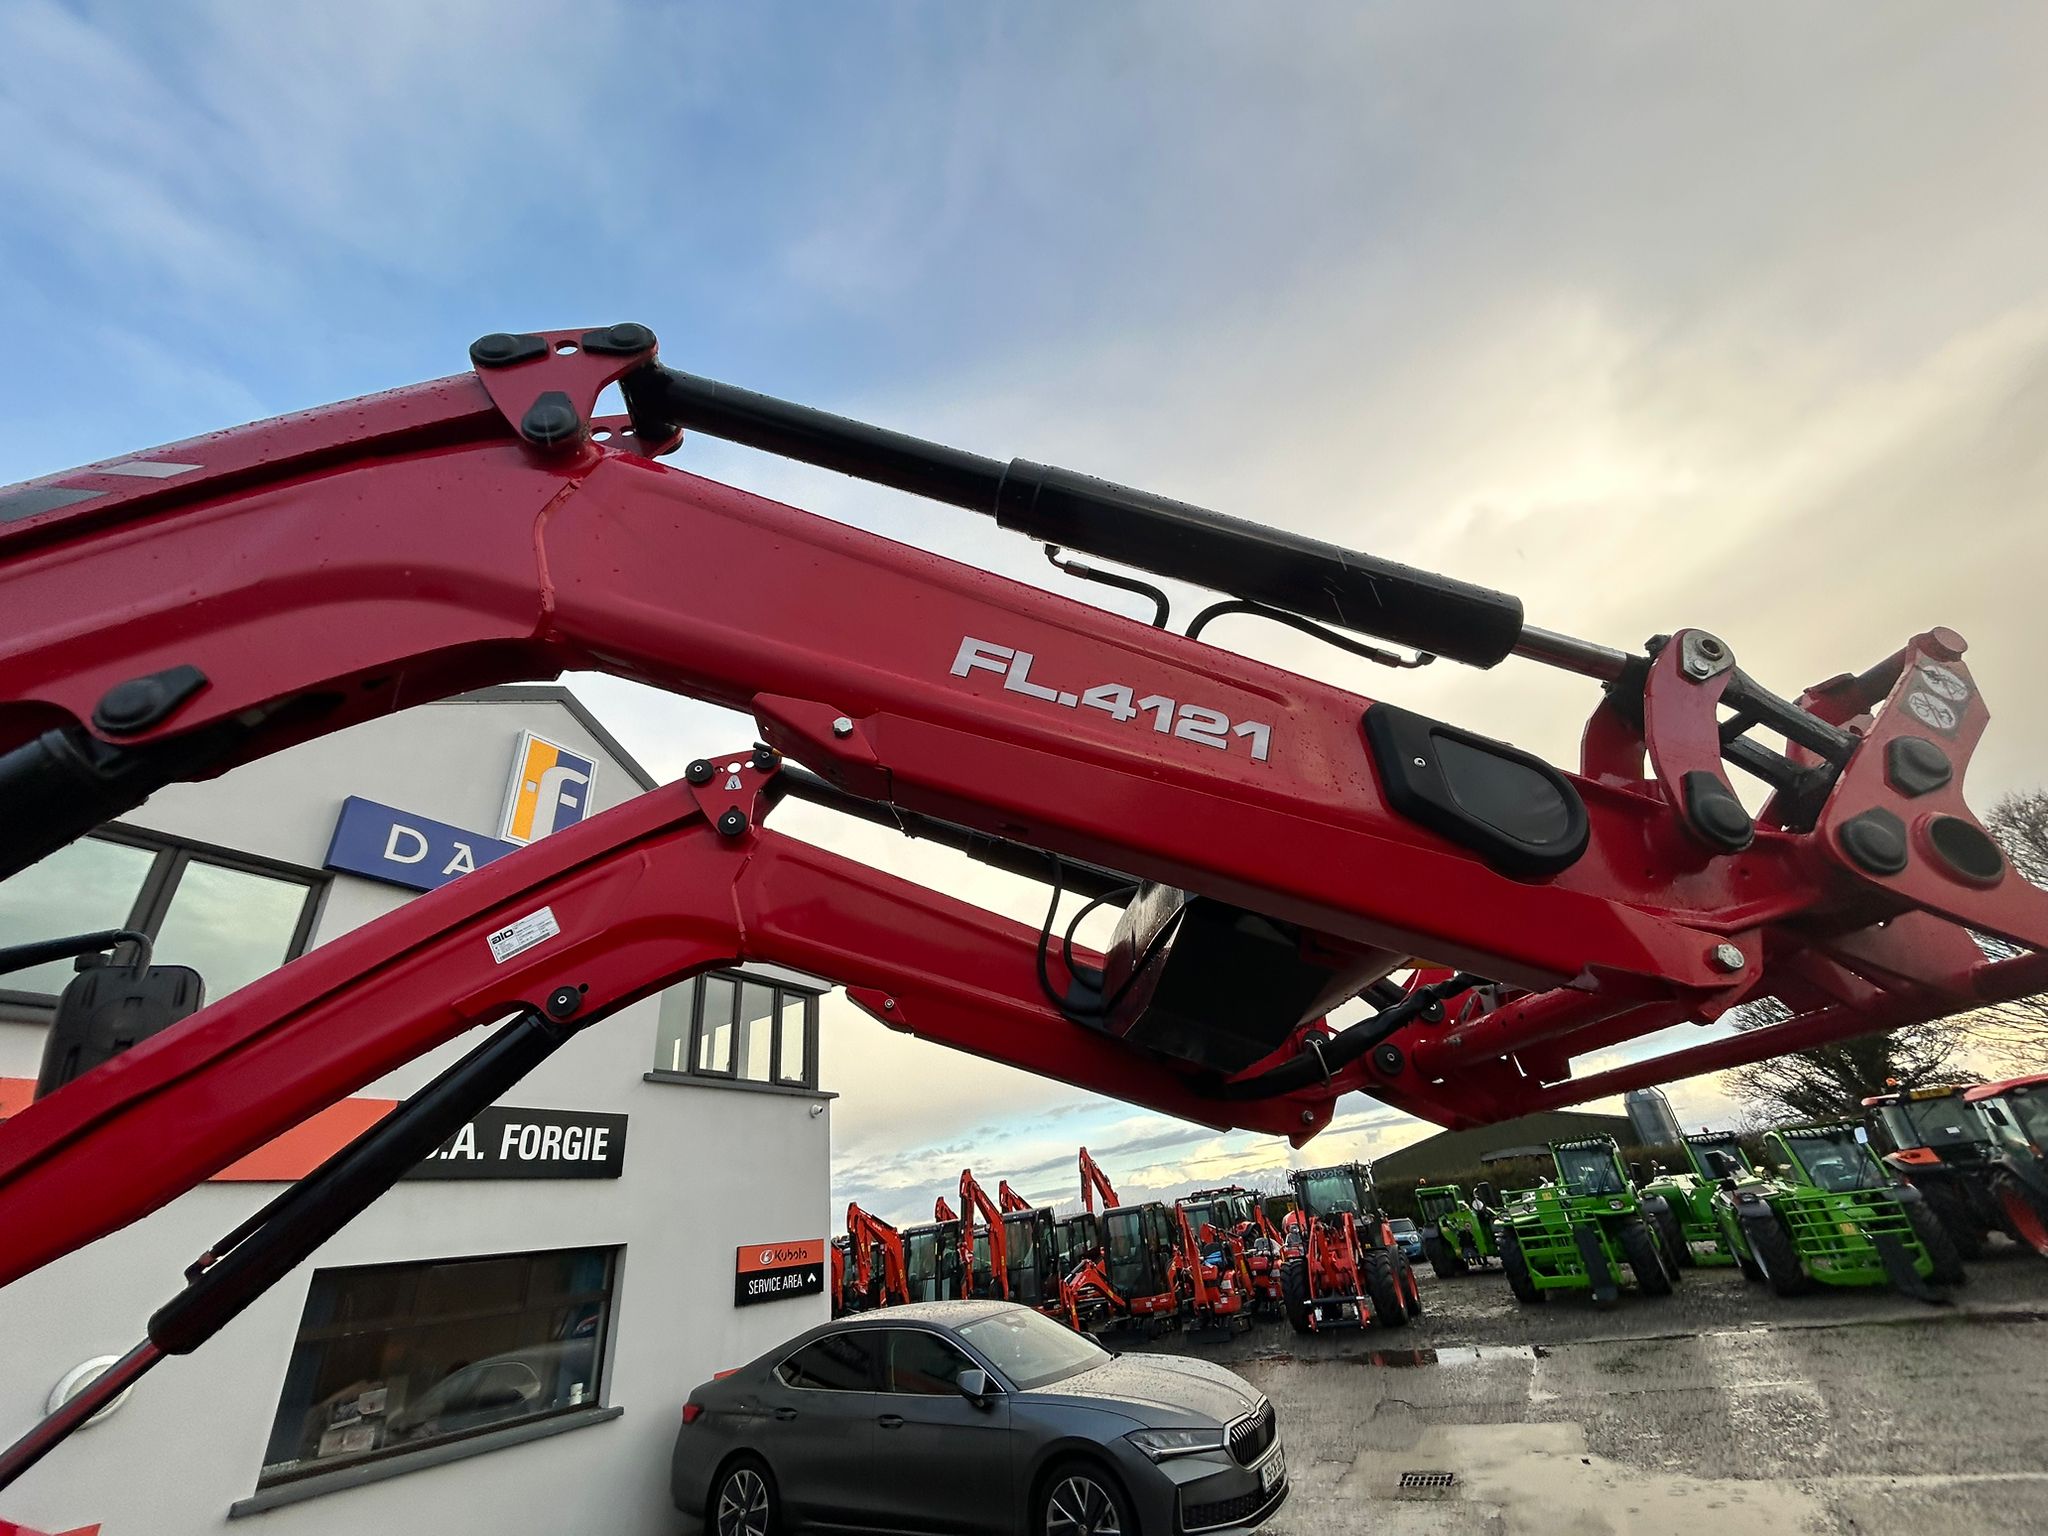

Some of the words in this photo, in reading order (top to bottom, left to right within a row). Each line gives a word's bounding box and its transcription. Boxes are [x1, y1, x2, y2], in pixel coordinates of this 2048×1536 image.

[949, 635, 1272, 761] FL.4121
[490, 928, 514, 945] alo
[425, 1122, 484, 1160] .A.
[498, 1123, 610, 1162] FORGIE
[1306, 1168, 1345, 1180] Kubota
[774, 1247, 808, 1262] Kubota
[748, 1276, 781, 1295] SERVICE
[782, 1273, 803, 1290] AREA
